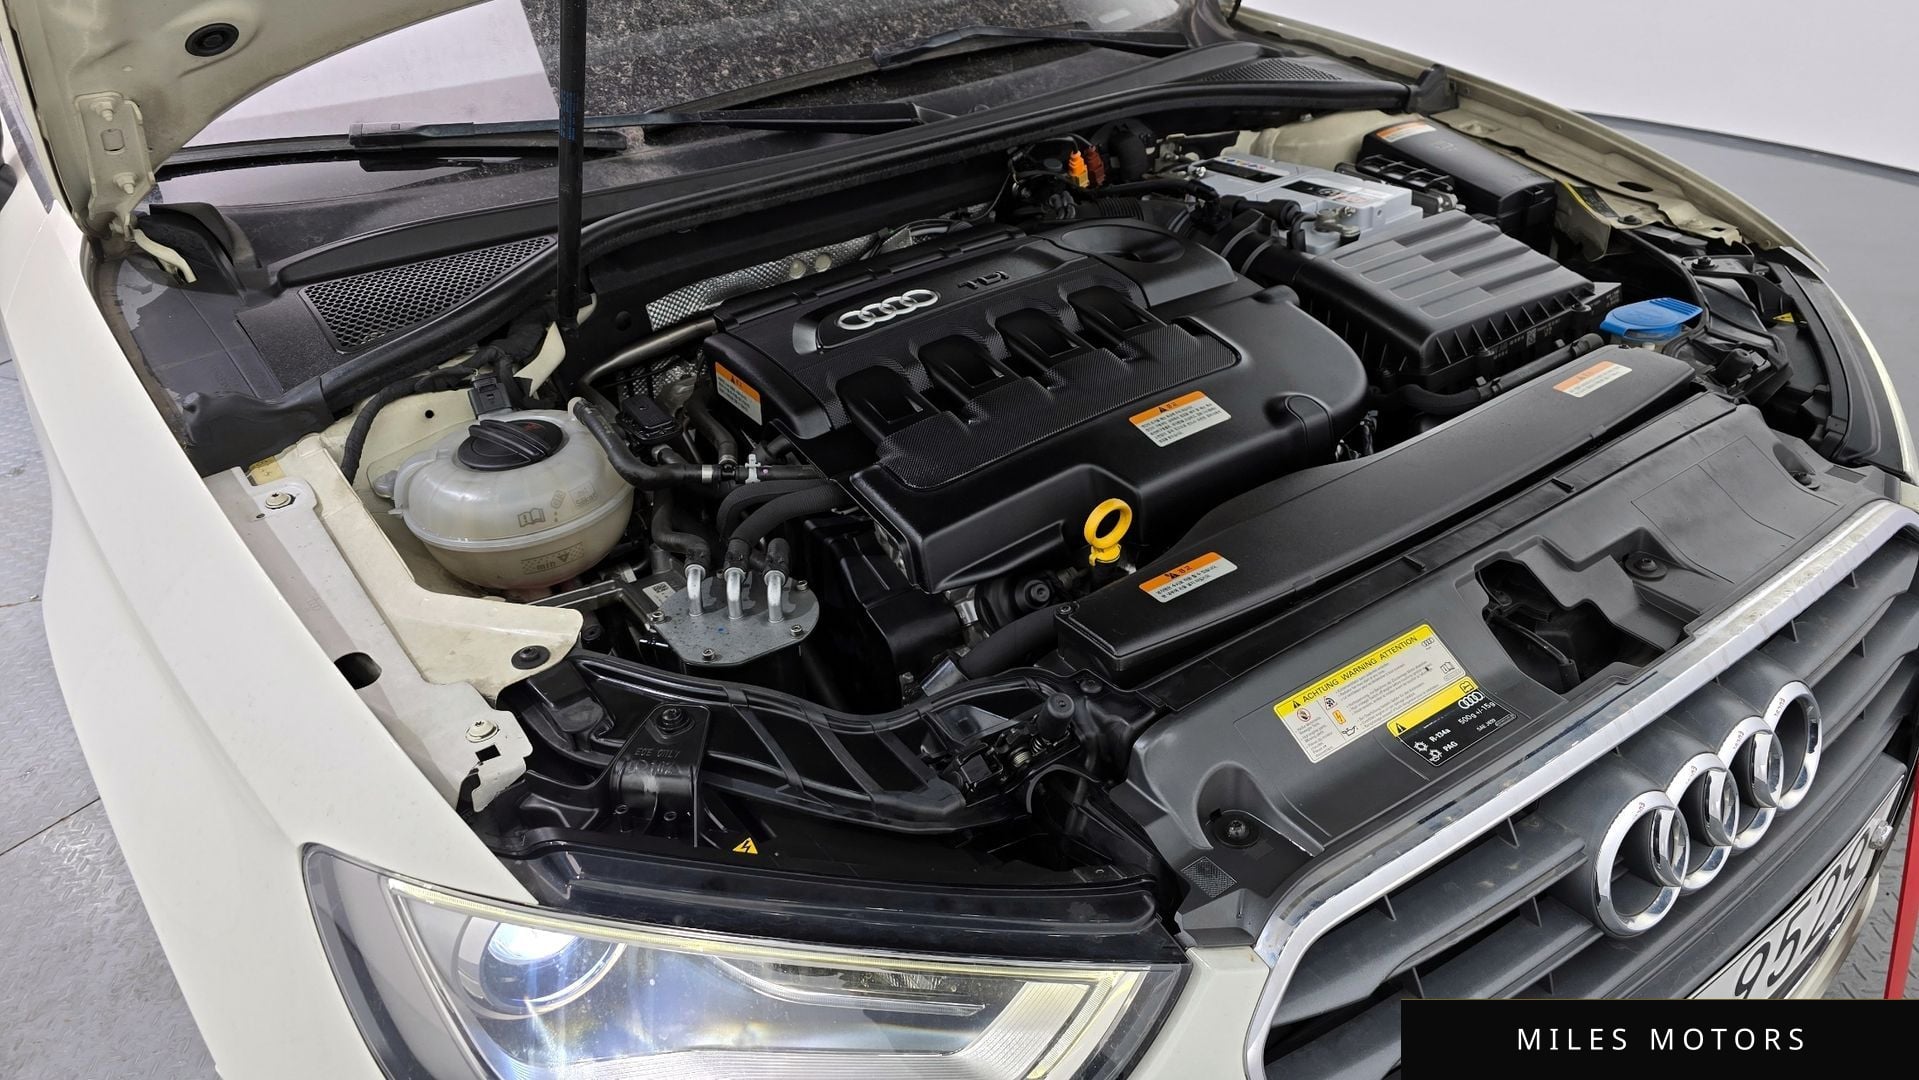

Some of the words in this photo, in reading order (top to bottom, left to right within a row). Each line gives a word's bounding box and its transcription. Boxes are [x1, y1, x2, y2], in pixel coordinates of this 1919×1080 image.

[1303, 679, 1340, 703] ACHTUNG
[1341, 658, 1378, 681] WARNING
[1380, 635, 1419, 661] ATTENTION
[1443, 740, 1458, 752] PAG
